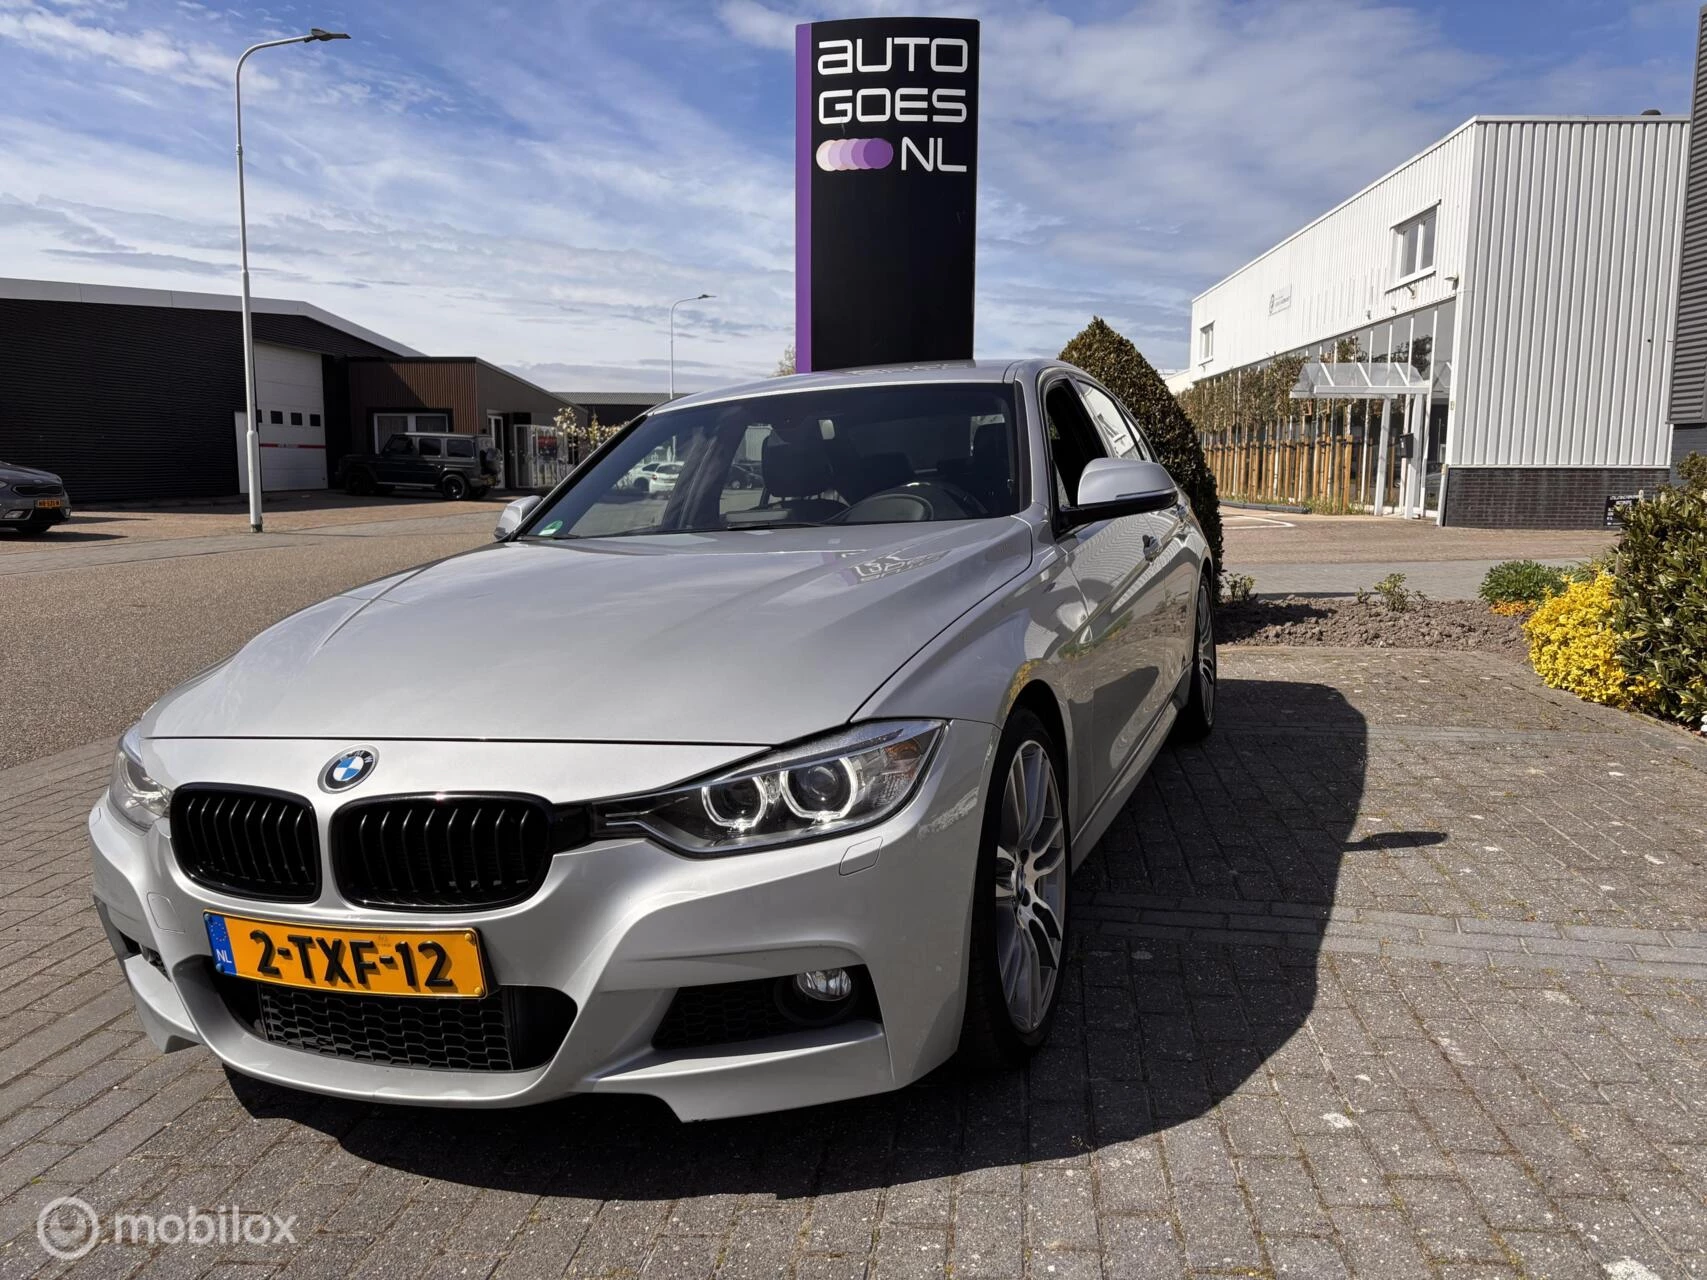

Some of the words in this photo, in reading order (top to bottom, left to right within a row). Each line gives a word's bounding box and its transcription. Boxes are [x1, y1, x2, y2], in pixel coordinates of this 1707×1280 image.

[818, 87, 967, 124] GOES
[901, 136, 967, 172] NL
[215, 949, 233, 964] NL
[249, 929, 454, 987] 2-TXF-12
